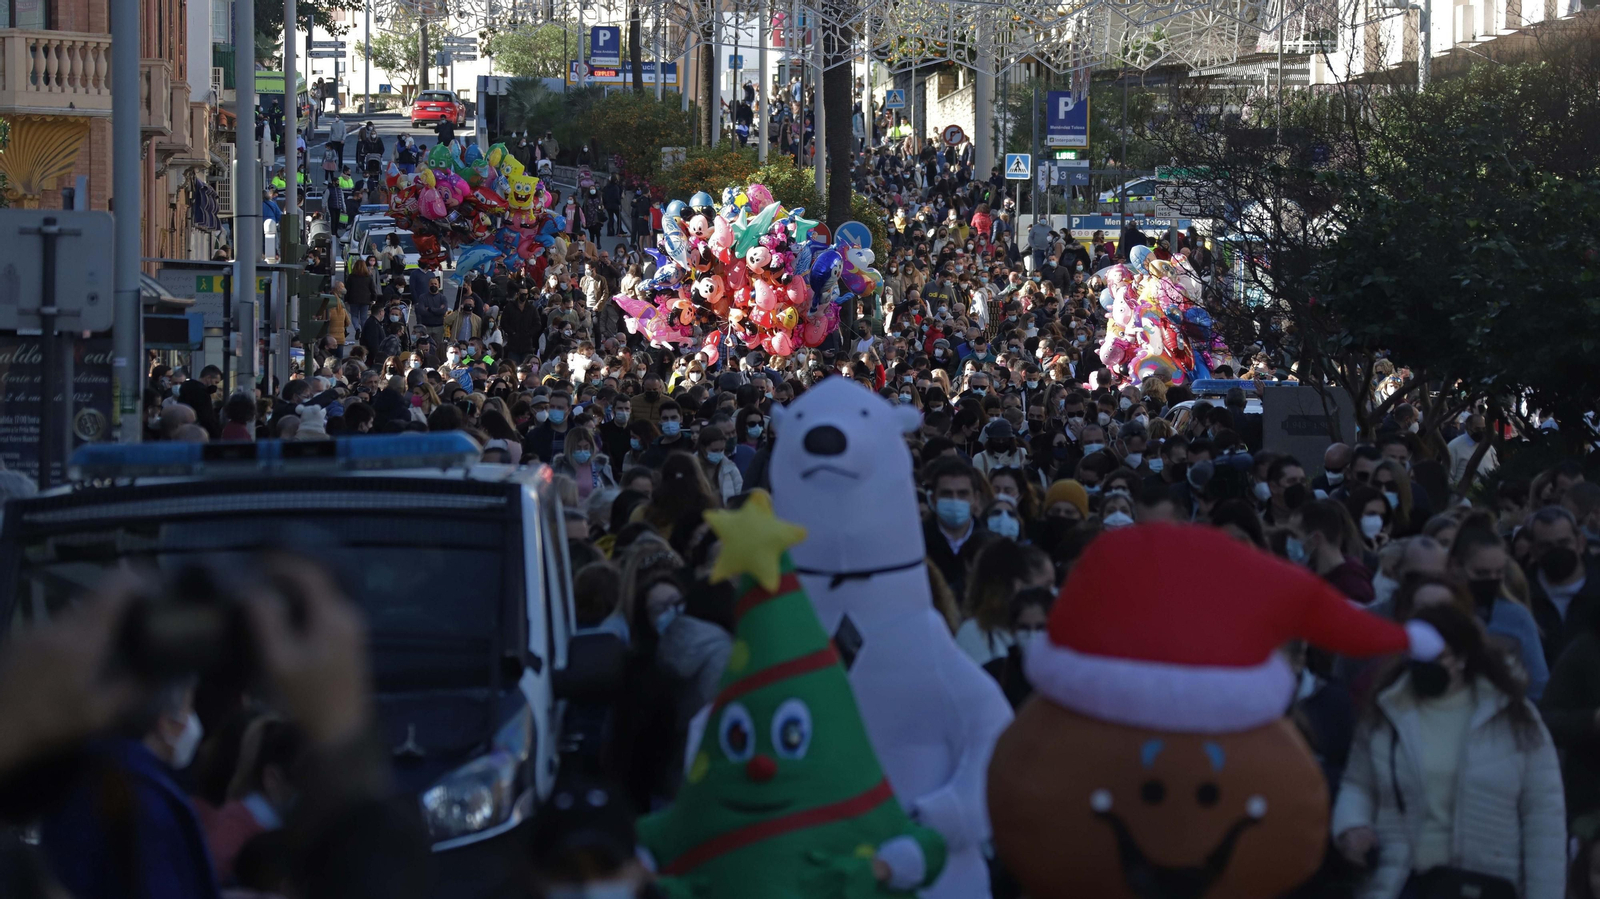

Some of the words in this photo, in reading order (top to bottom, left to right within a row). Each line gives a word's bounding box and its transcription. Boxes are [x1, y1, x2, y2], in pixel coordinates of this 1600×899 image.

[599, 29, 611, 46] P
[1058, 96, 1075, 119] P
[1056, 152, 1076, 160] LIBRE
[1072, 217, 1080, 228] P
[1104, 218, 1144, 226] Mennez
[73, 371, 109, 383] duinos
[73, 392, 93, 402] 022
